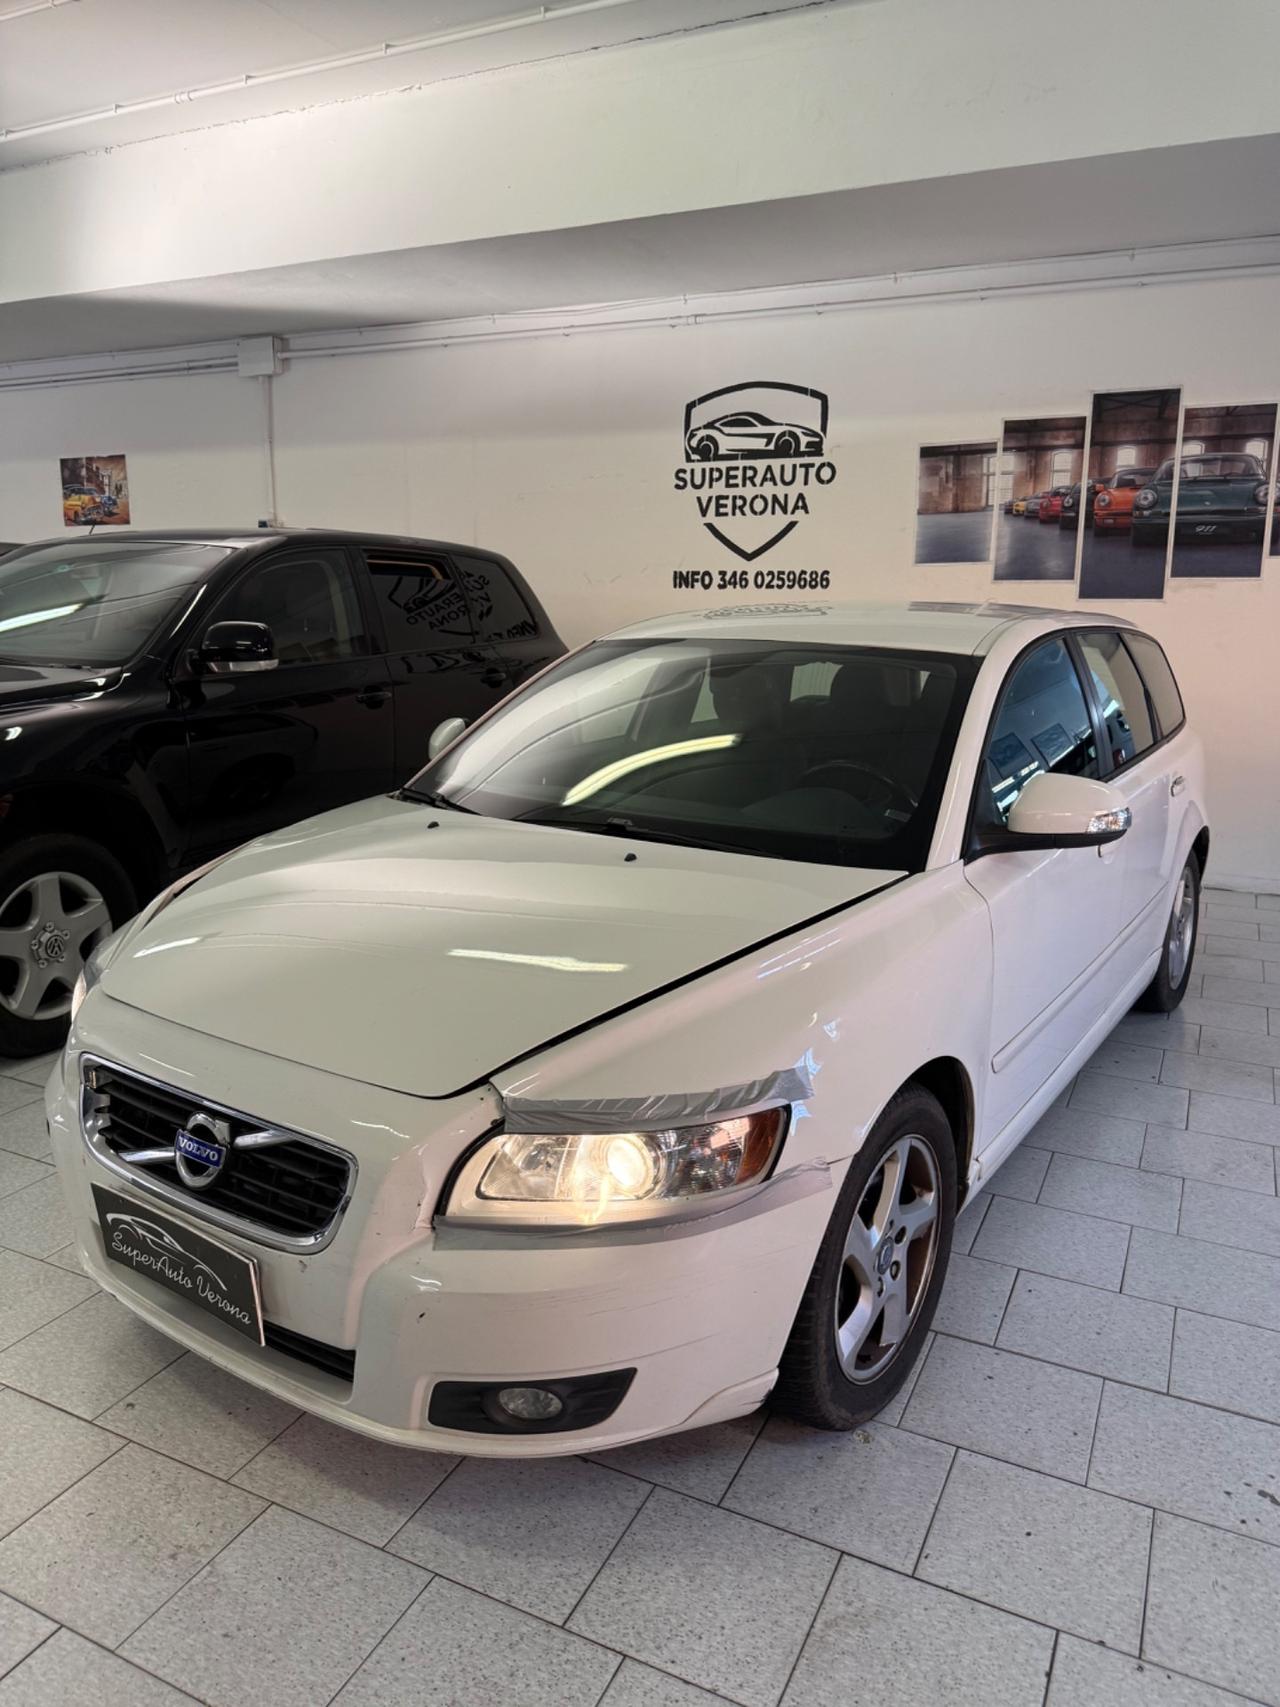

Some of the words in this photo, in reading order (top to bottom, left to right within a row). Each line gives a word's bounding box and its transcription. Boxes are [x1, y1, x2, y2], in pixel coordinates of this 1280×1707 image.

[674, 461, 837, 490] SUPERAUTO
[696, 492, 810, 518] VERONA
[1195, 525, 1217, 533] 911
[672, 570, 713, 590] INFO
[717, 570, 749, 590] 346
[754, 570, 831, 590] 0259686
[178, 1135, 219, 1161] VOLVO
[111, 1231, 193, 1288] SuperAuto
[196, 1275, 252, 1325] Verona
